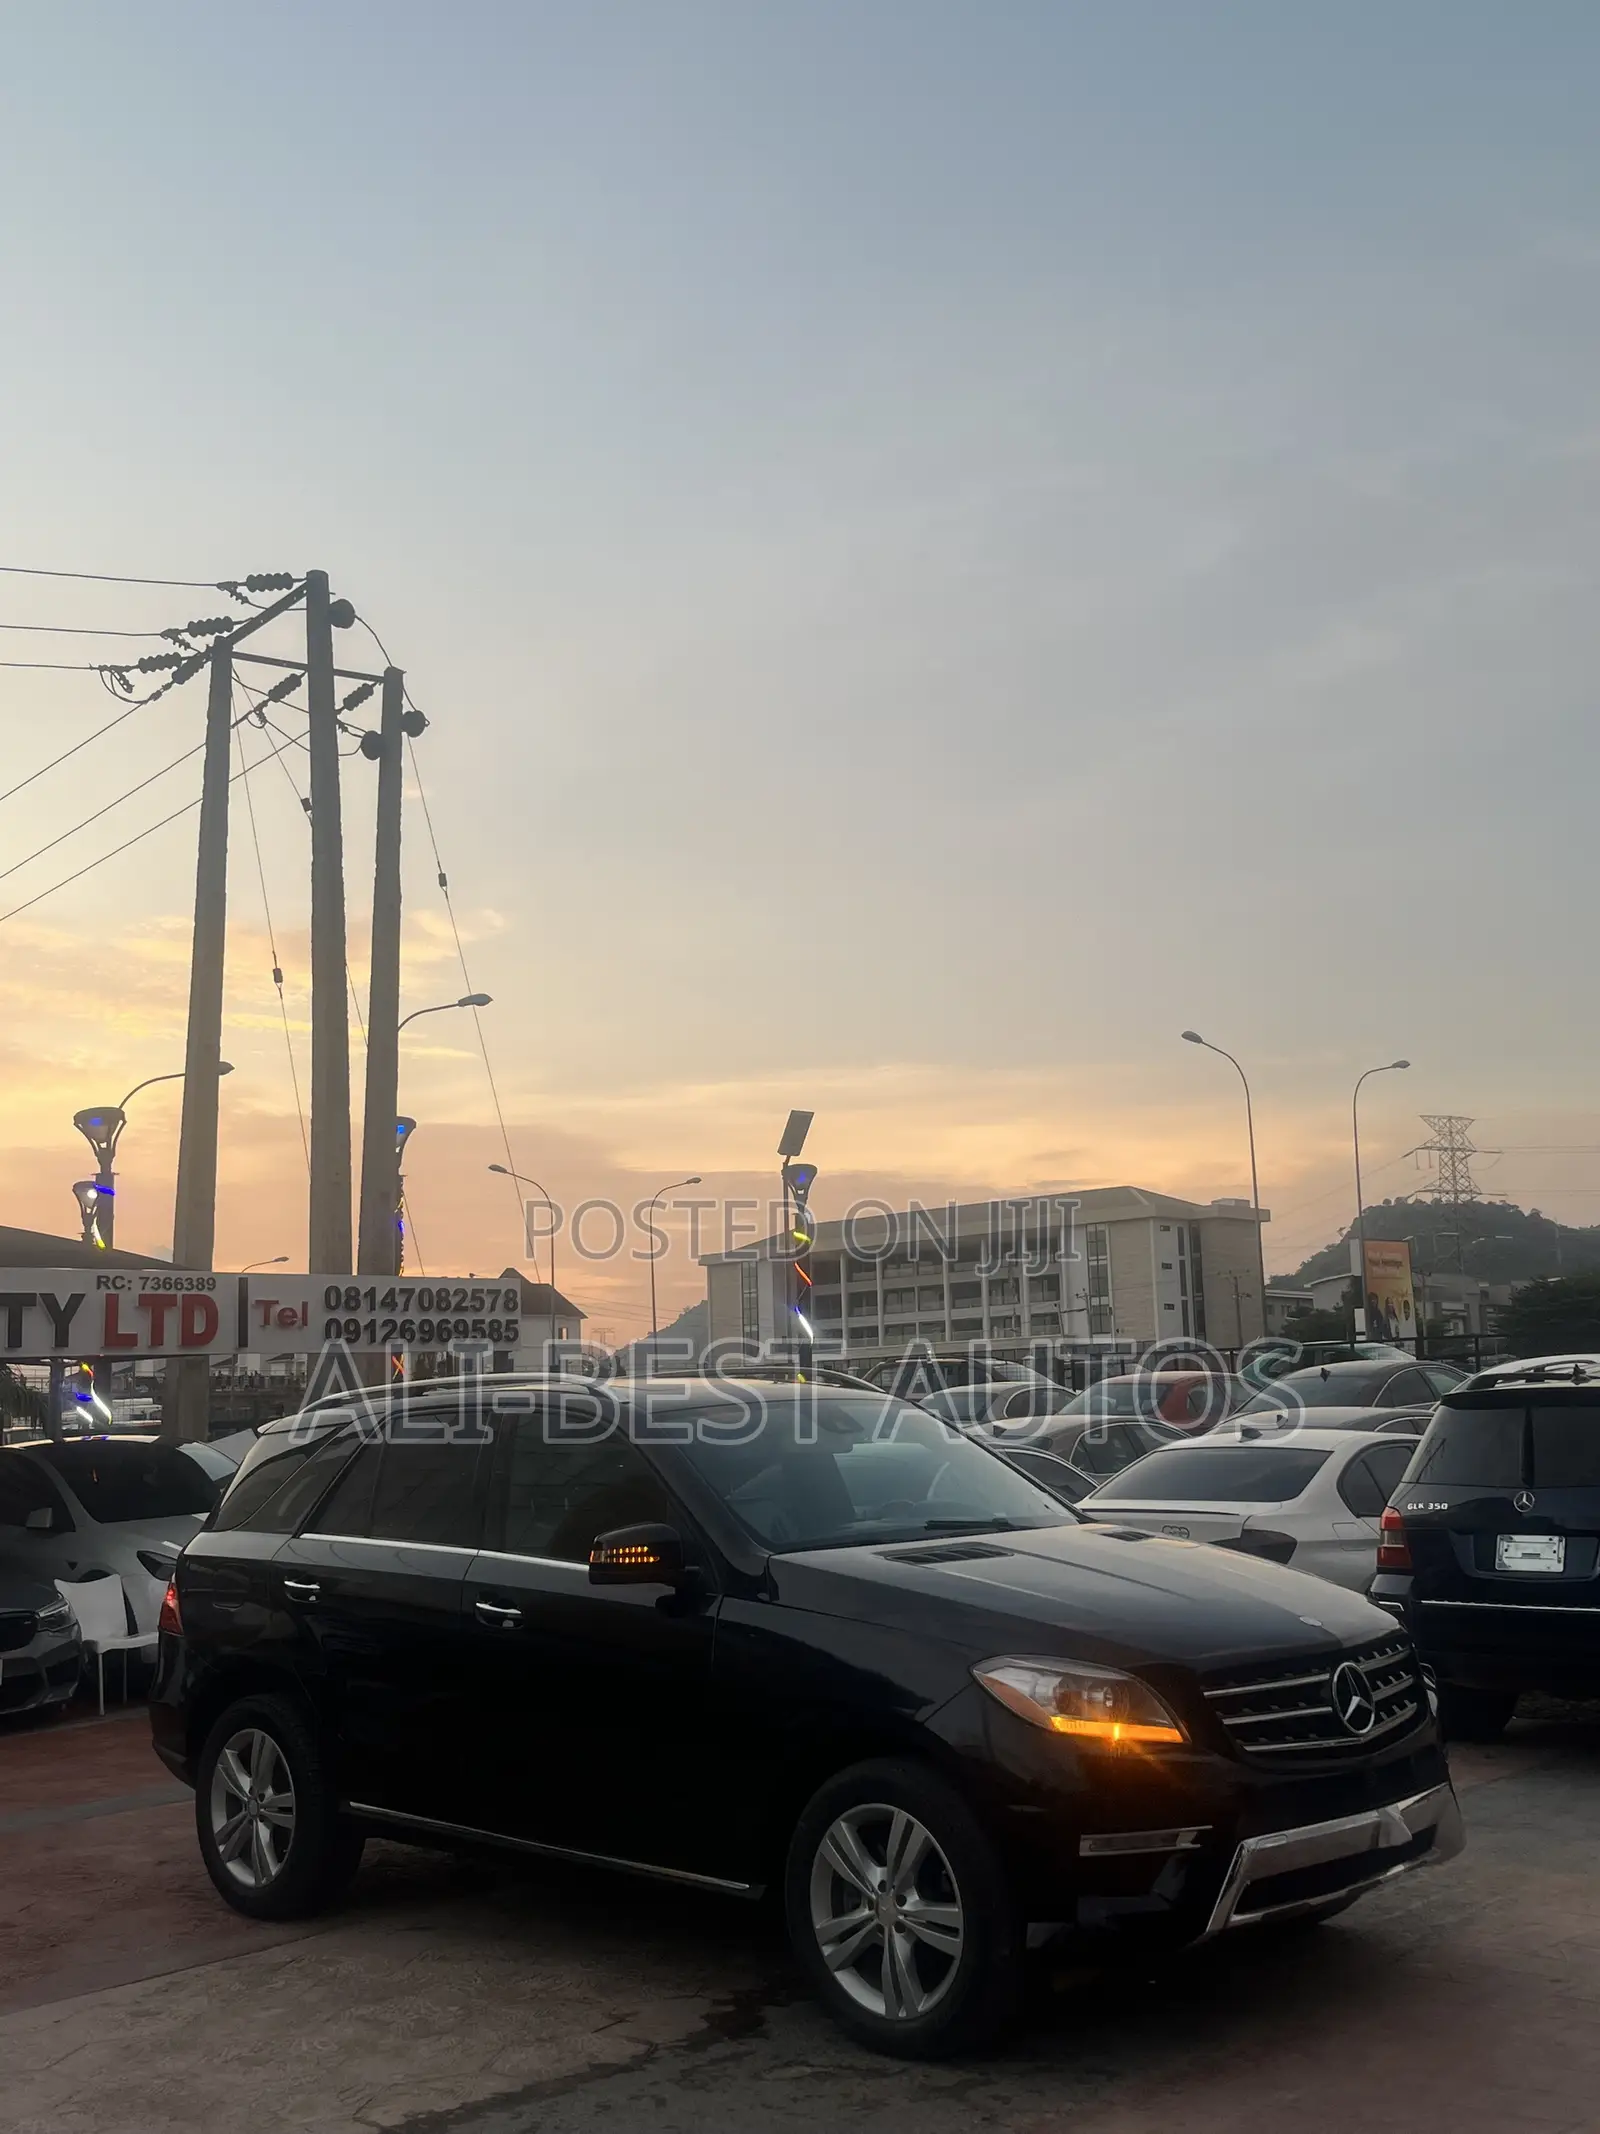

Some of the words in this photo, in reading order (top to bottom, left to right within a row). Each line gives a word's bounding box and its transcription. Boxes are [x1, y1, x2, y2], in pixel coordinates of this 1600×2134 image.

[96, 1275, 132, 1291] RC:
[139, 1276, 217, 1291] 7366389
[324, 1285, 519, 1313] 08147082578
[104, 1293, 219, 1347] LTD
[255, 1300, 309, 1328] Tel
[324, 1318, 519, 1345] 09126969585
[1407, 1502, 1424, 1510] GLK
[1428, 1502, 1448, 1510] 350
